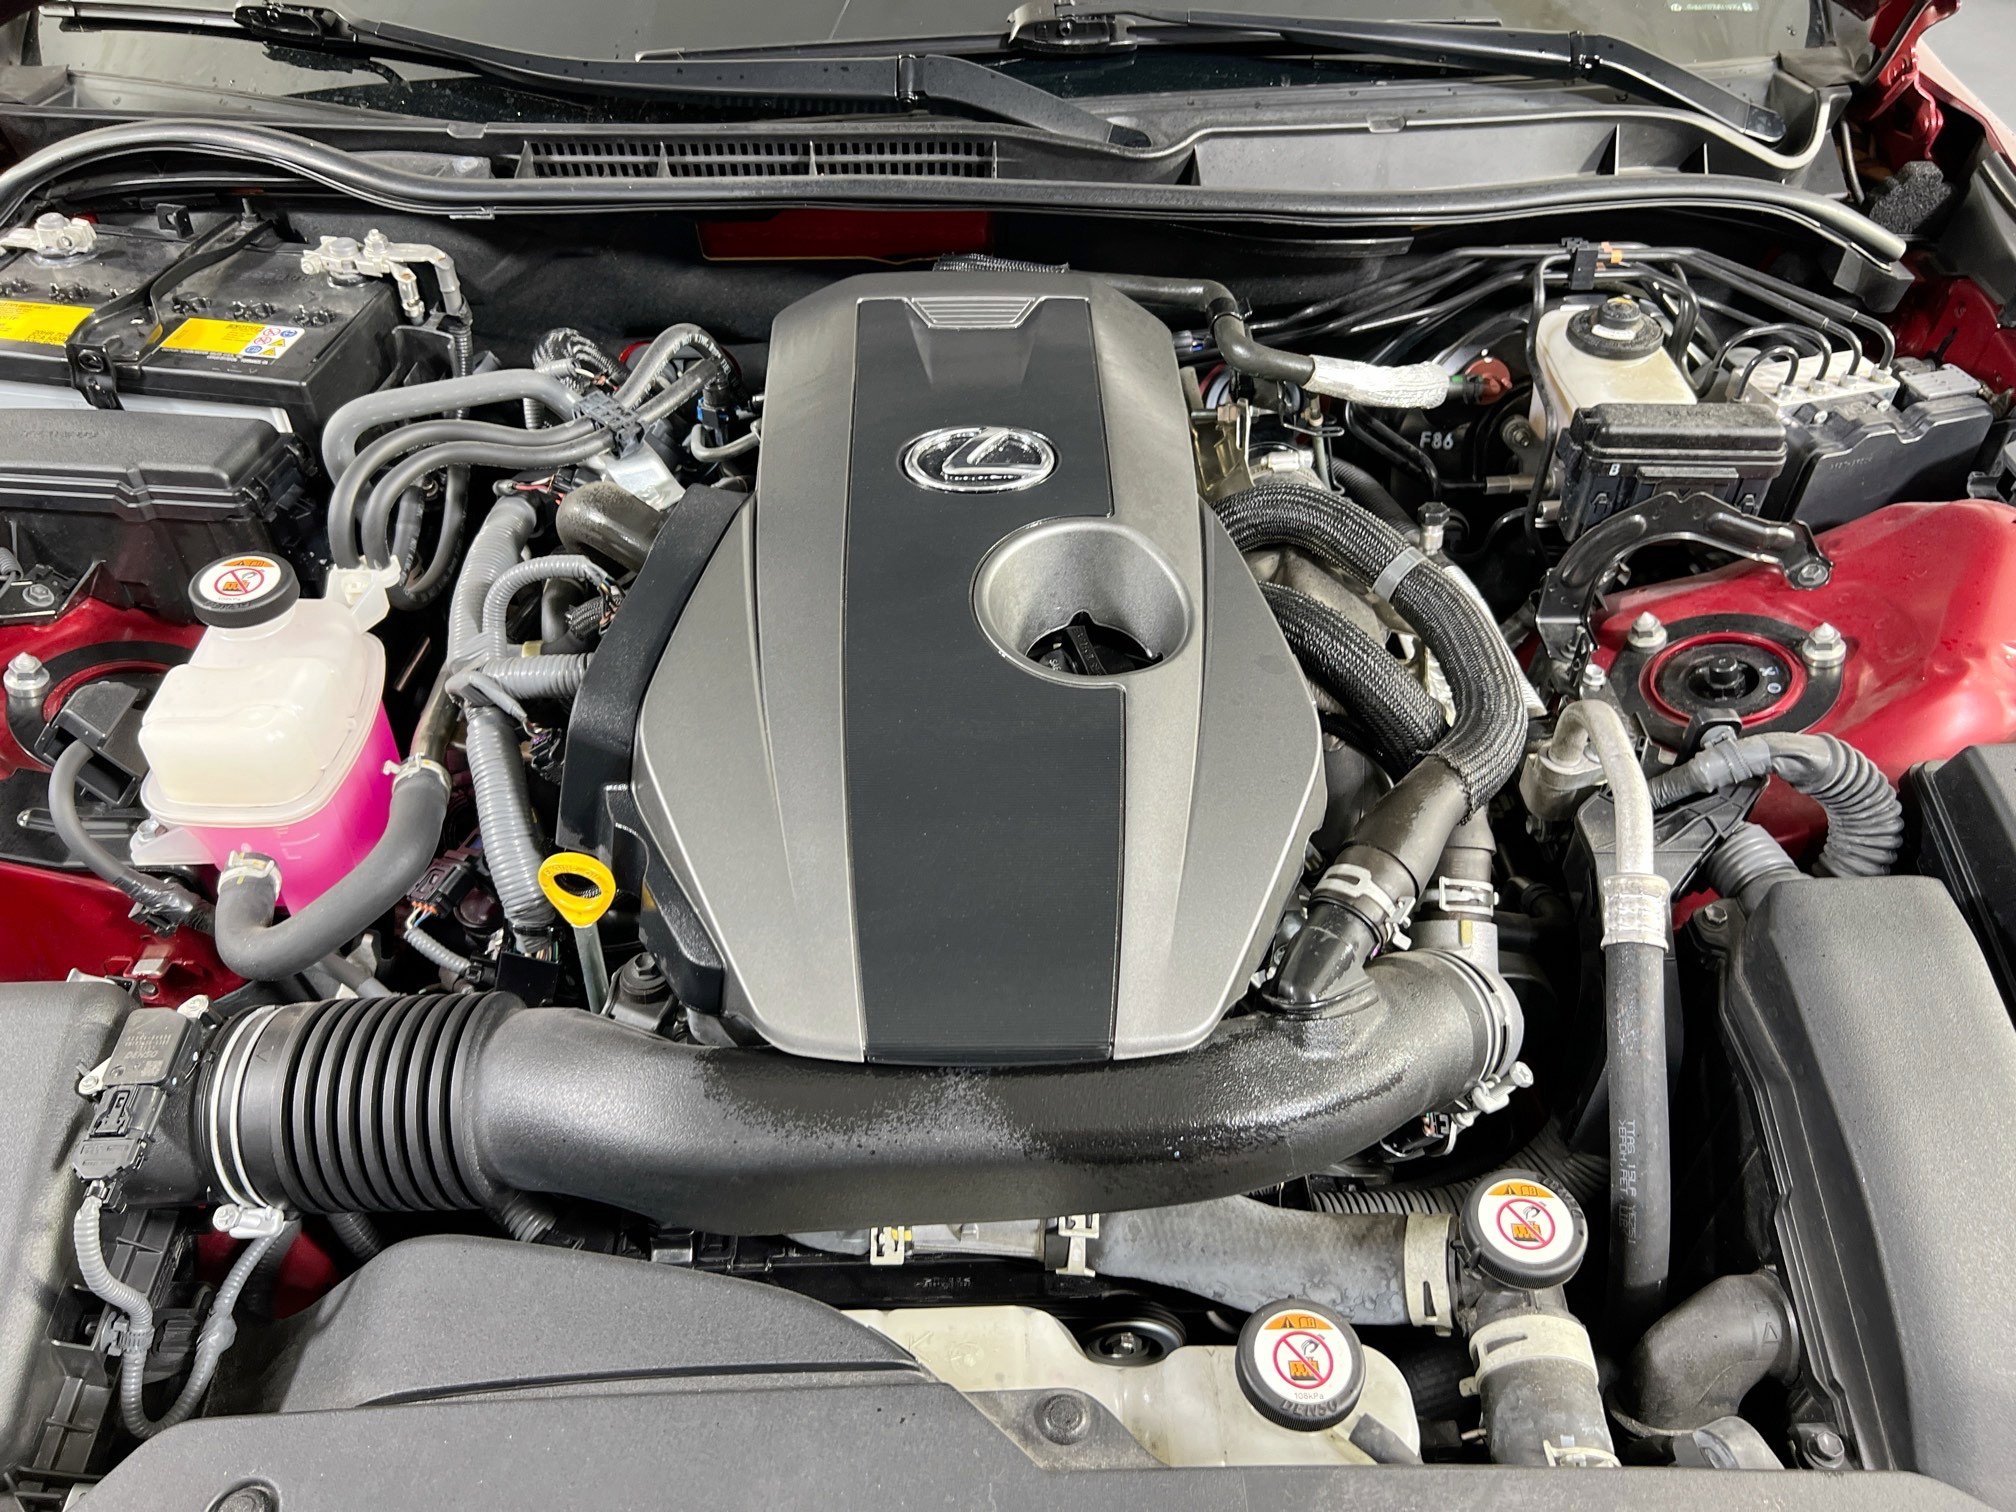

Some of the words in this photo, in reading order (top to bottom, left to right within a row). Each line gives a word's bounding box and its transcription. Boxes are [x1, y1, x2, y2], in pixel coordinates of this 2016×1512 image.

[1419, 431, 1454, 450] F86
[1608, 463, 1621, 477] B
[1294, 1392, 1325, 1400] 108kPa
[1280, 1400, 1338, 1417] DENSO
